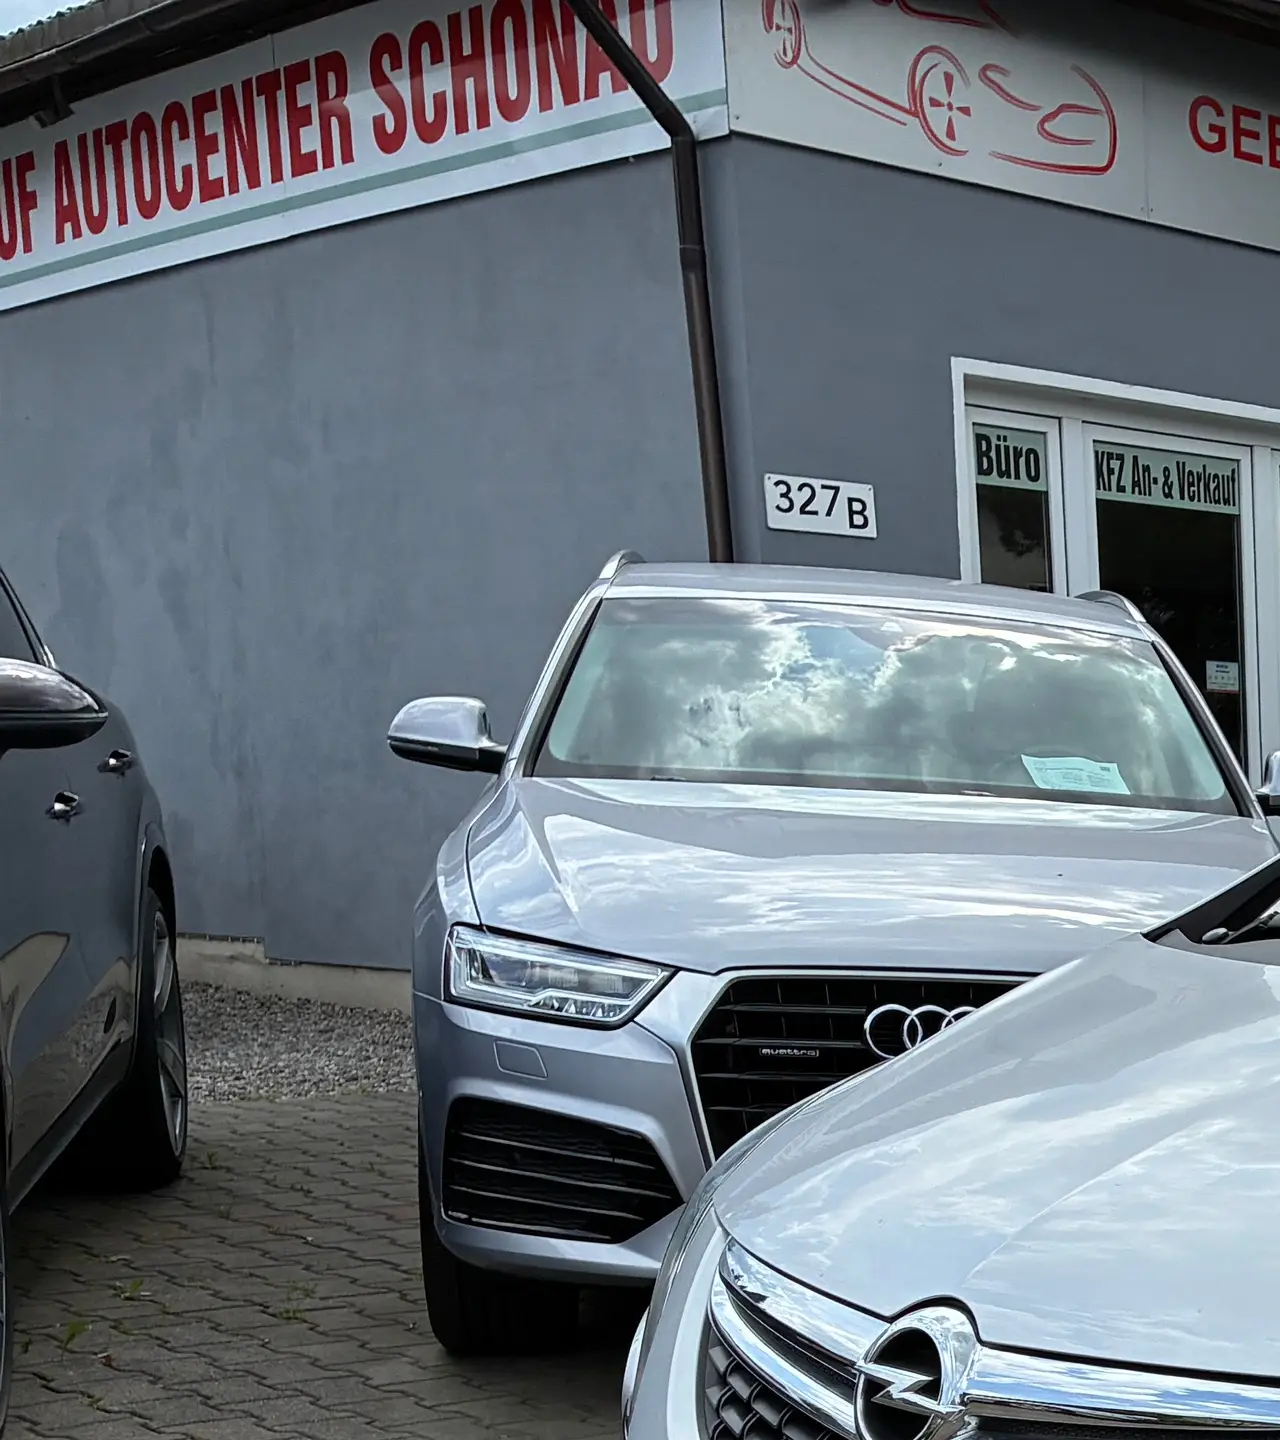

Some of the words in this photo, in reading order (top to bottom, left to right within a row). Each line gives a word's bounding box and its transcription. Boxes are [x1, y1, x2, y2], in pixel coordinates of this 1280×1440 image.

[54, 50, 355, 245] AUTOCENTER
[975, 432, 1041, 483] Büro
[1094, 449, 1126, 494] KFZ
[1131, 454, 1159, 497] An-
[1161, 467, 1174, 499] &
[1176, 460, 1238, 508] Verkauf
[773, 480, 840, 517] 327
[848, 497, 869, 529] B
[761, 1048, 817, 1056] quattro
